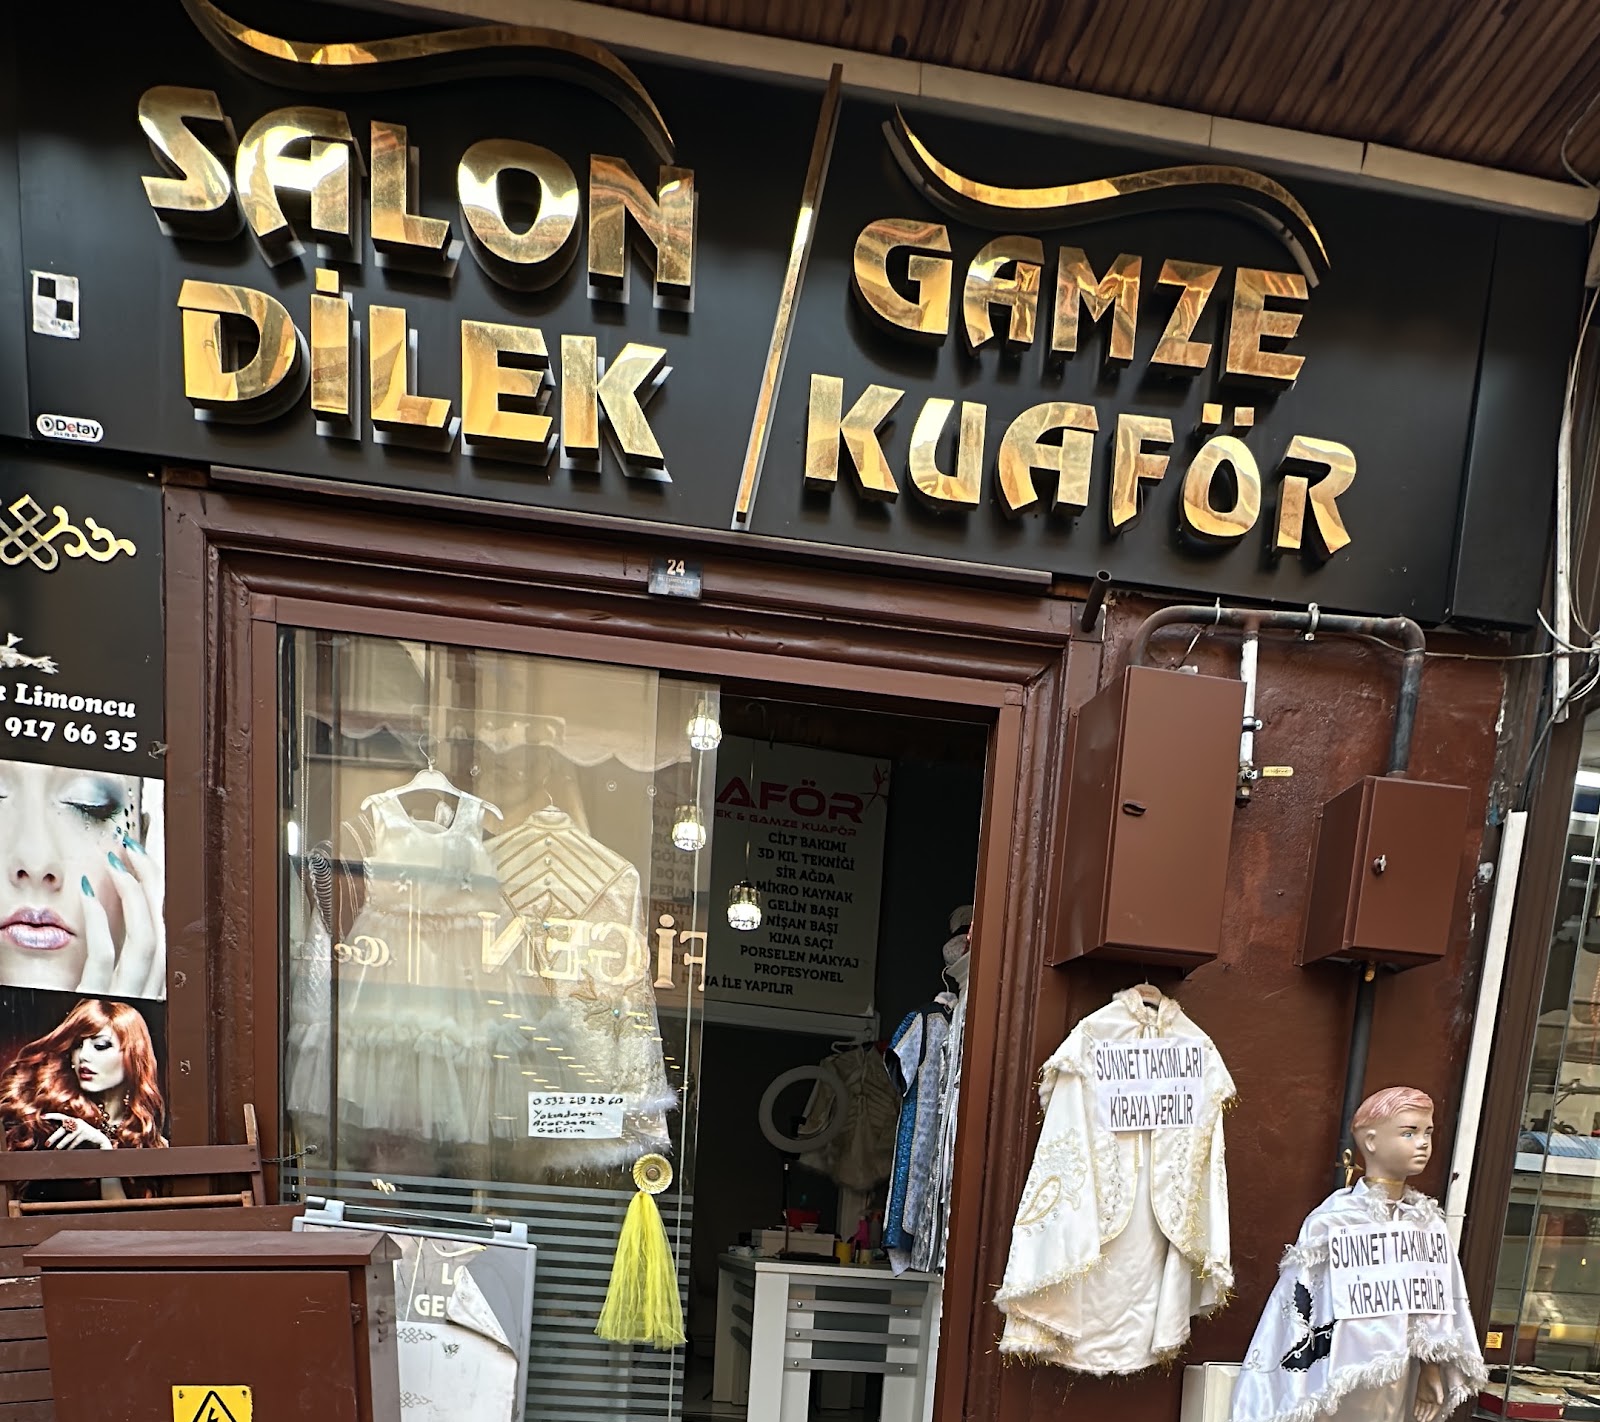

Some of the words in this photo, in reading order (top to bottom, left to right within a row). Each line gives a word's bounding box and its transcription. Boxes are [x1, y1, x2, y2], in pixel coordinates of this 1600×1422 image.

[138, 85, 695, 294] SALON
[853, 218, 1309, 387] GAMZE
[177, 268, 667, 470] DİLEK
[56, 419, 100, 438] Detay
[804, 374, 1358, 558] KUAFÖR
[667, 559, 686, 577] 24
[15, 683, 136, 718] Limoncu
[5, 716, 56, 742] 917
[63, 721, 97, 745] 66
[103, 729, 138, 752] 35
[716, 776, 864, 824] AFÖR
[750, 814, 798, 829] GAMZE
[768, 830, 798, 846] CİLT
[800, 836, 847, 854] BAKIMI
[757, 847, 775, 860] 3D
[778, 850, 798, 863] KIL
[801, 852, 856, 872] TEKNİĞİ
[776, 864, 797, 880] SİR
[799, 868, 836, 885] AĞDA
[756, 880, 799, 896] MİKRO
[802, 886, 854, 904] KAYNAK
[767, 898, 807, 914] GELİN
[810, 903, 839, 920] BAŞI
[765, 913, 807, 931] NİŞAN
[810, 919, 839, 937] BAŞI
[768, 931, 801, 946] KINA
[804, 935, 834, 952] SAÇI
[740, 944, 806, 963] PORSELEN
[808, 952, 859, 969] MAKYAJ
[722, 973, 742, 990] İLE
[744, 979, 793, 996] YAPILIR
[753, 962, 844, 983] PROFESYONEL
[1096, 1042, 1141, 1081] SÜNNET
[1142, 1047, 1202, 1080] TAKIMLARI
[544, 1096, 565, 1106] 532
[1110, 1088, 1151, 1128] KİRAYA
[1152, 1085, 1194, 1126] VERİLİR
[1331, 1228, 1387, 1269] SÜNNET
[1391, 1230, 1448, 1264] TAKIMLARI
[1348, 1275, 1403, 1315] KİRAYA
[1402, 1270, 1445, 1311] VERİLİR
